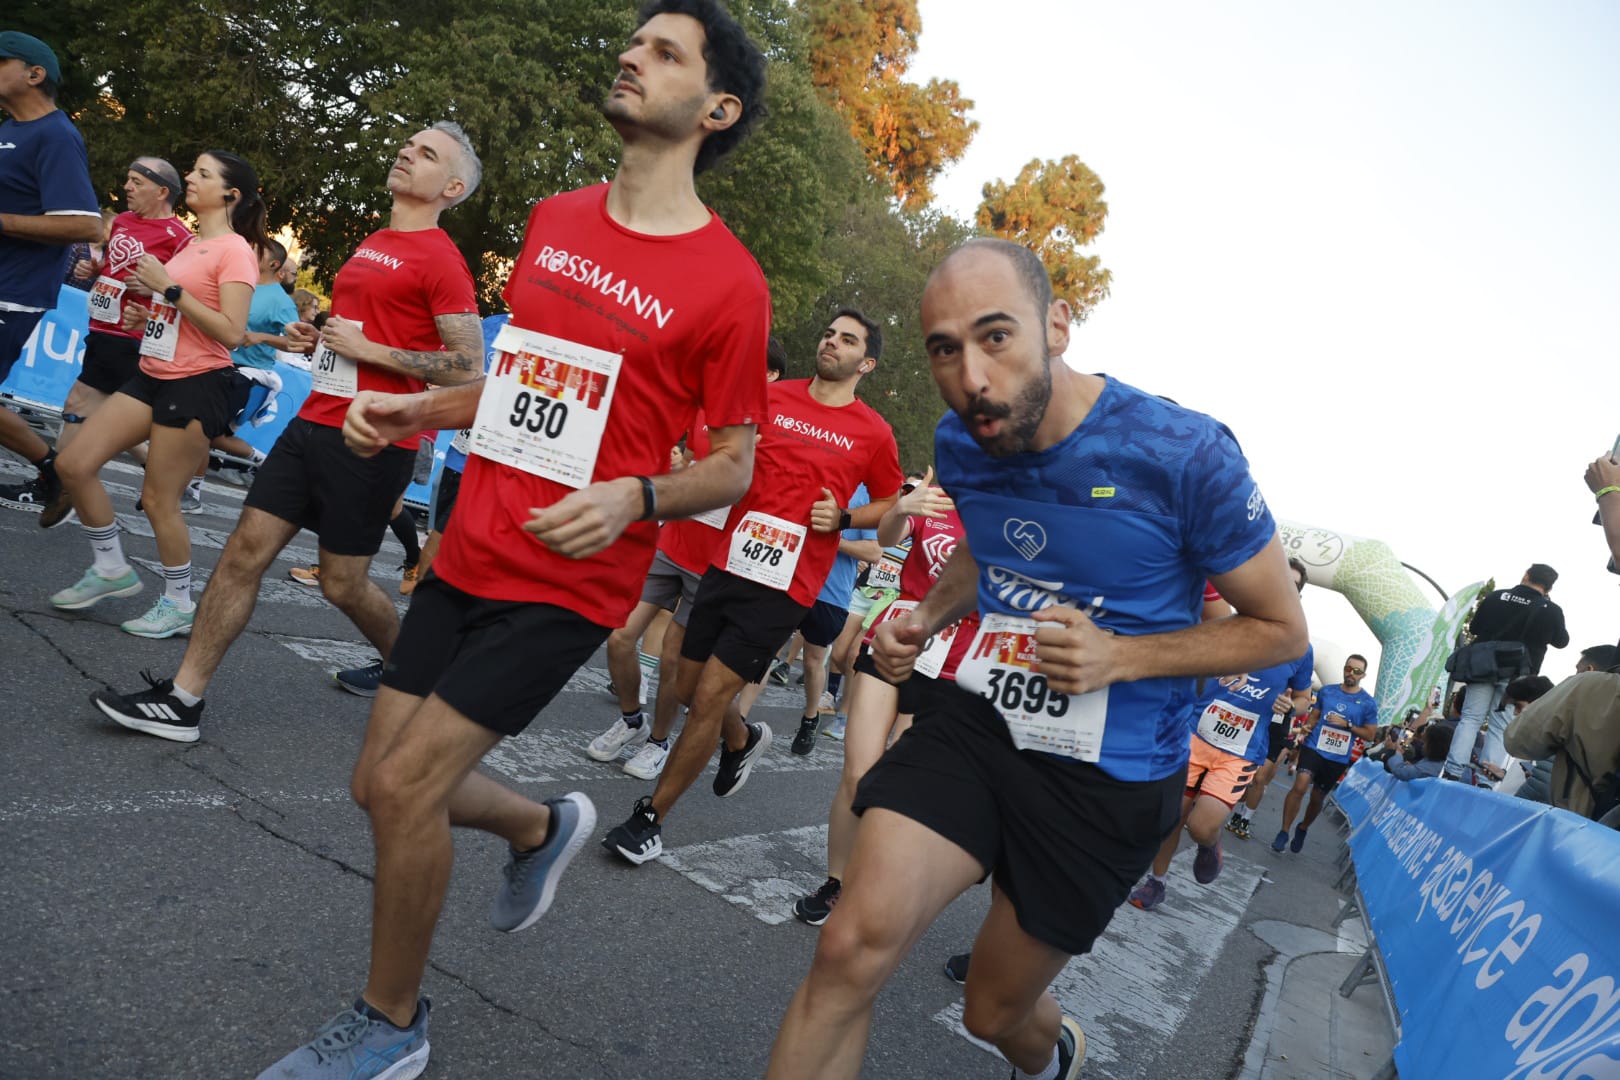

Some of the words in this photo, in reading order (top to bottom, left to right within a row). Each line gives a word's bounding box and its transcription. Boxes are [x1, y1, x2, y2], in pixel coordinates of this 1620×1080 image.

[534, 245, 674, 329] ROSSMANN
[145, 319, 164, 339] 98
[509, 391, 568, 439] 930
[773, 414, 854, 451] ROSSMANN
[742, 540, 783, 567] 4878
[875, 570, 897, 583] 3303
[980, 668, 1069, 718] 3695
[1213, 721, 1240, 740] 1601
[1325, 738, 1343, 748] 2913
